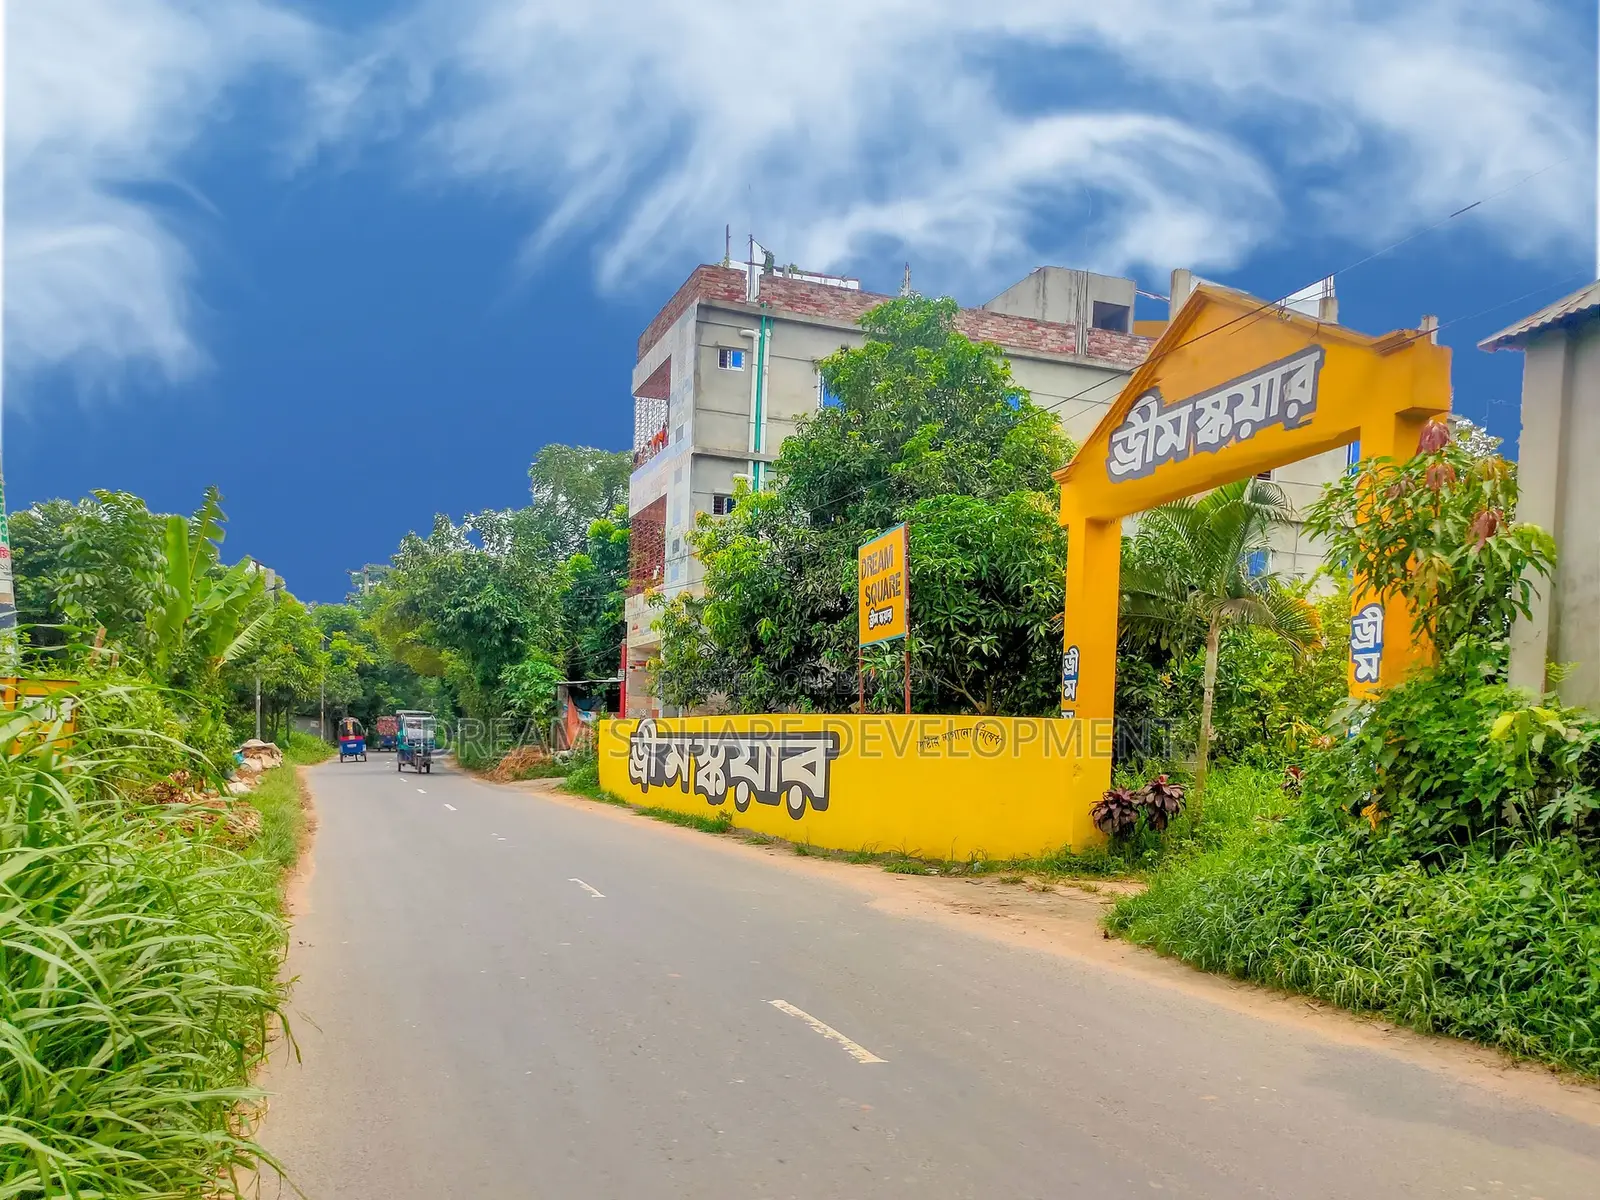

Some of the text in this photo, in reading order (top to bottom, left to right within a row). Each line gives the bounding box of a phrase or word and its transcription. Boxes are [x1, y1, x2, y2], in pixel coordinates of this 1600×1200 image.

[861, 543, 894, 580] DREAM
[865, 572, 902, 607] SQUARE
[975, 721, 1003, 746] নিষেধ
